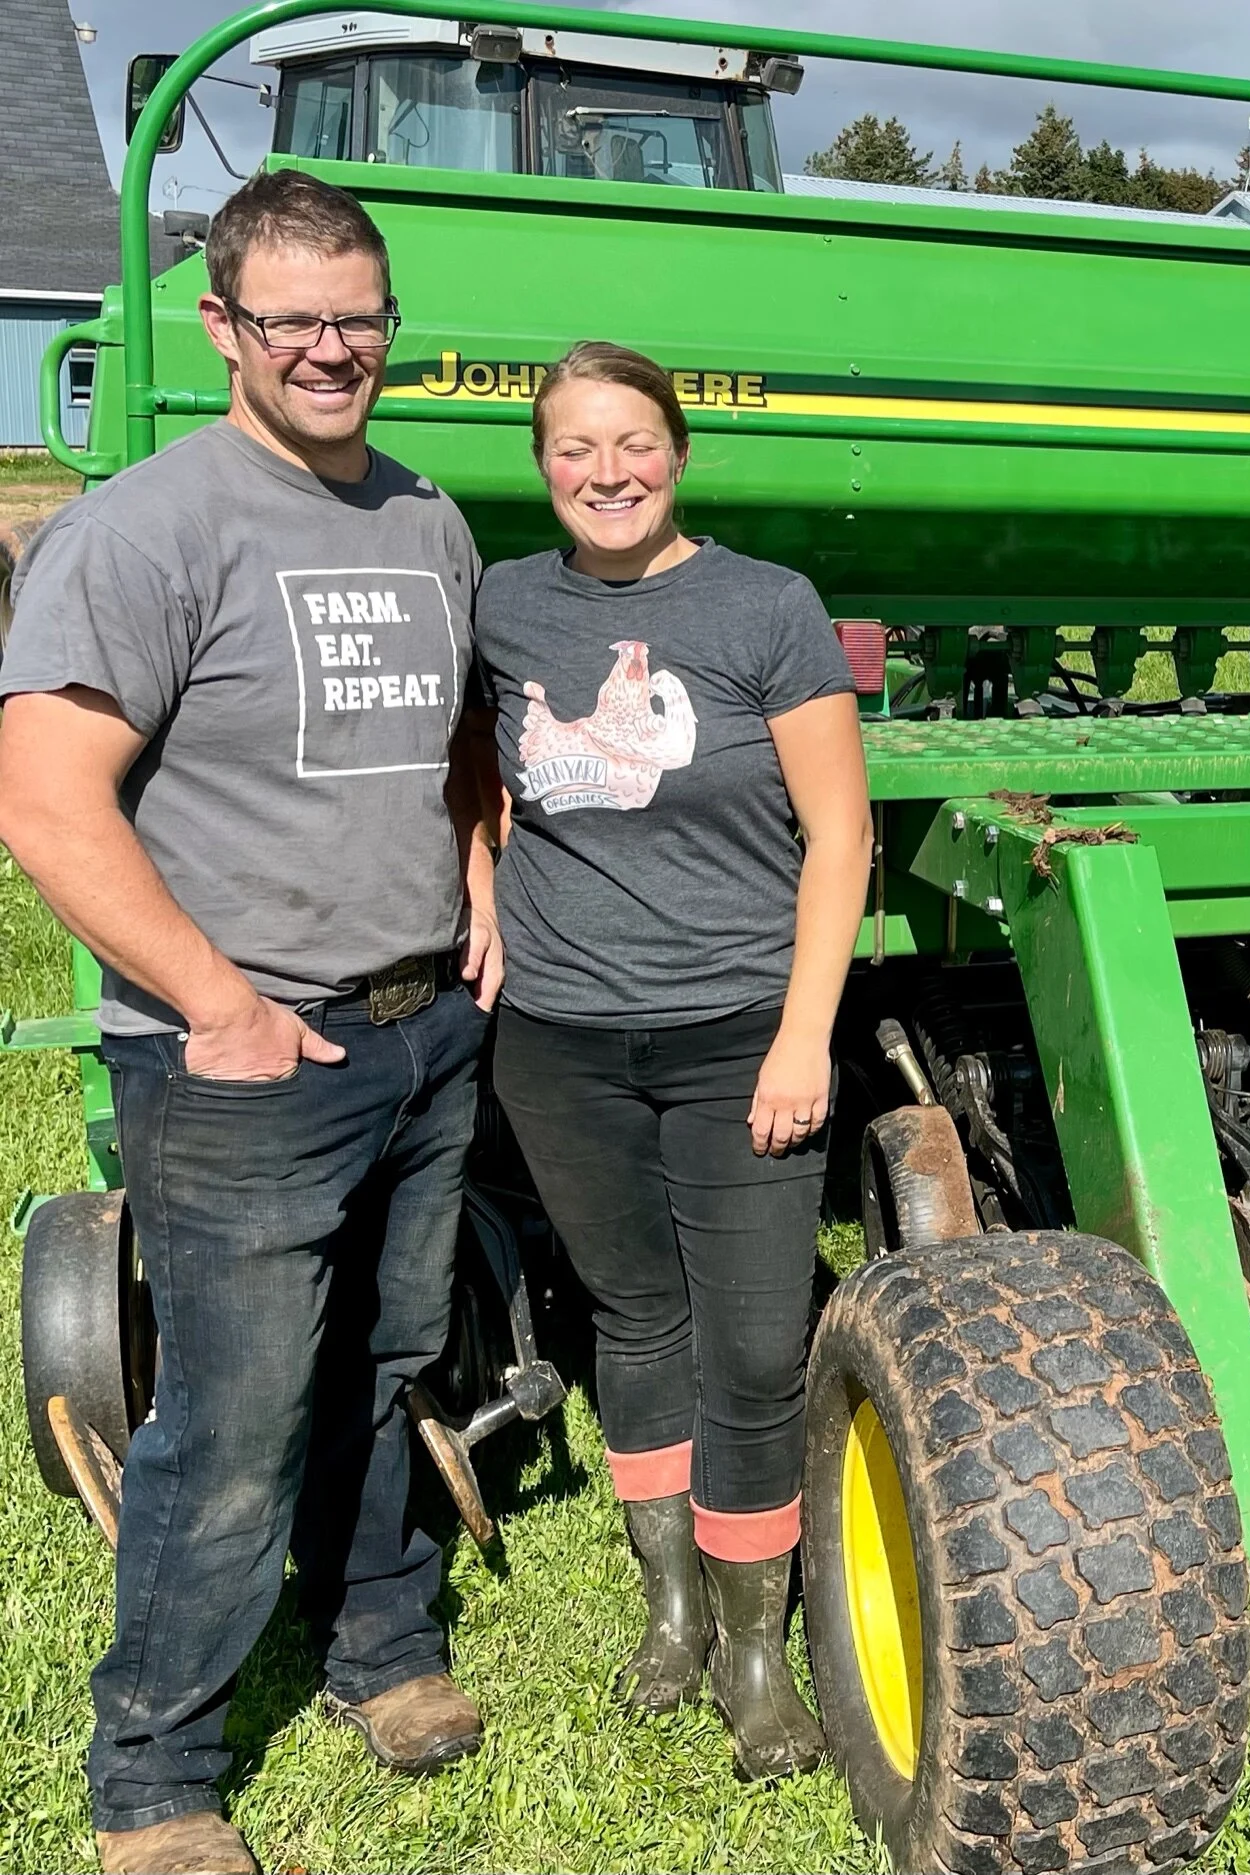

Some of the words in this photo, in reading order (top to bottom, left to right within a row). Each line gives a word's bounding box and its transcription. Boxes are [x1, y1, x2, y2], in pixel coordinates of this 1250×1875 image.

[672, 371, 767, 408] ERE
[303, 592, 411, 624] FARM.
[314, 633, 381, 667] EAT.
[322, 674, 445, 712] REPEAT.
[528, 759, 605, 795] BARNYARD
[546, 795, 604, 808] ORGANICS
